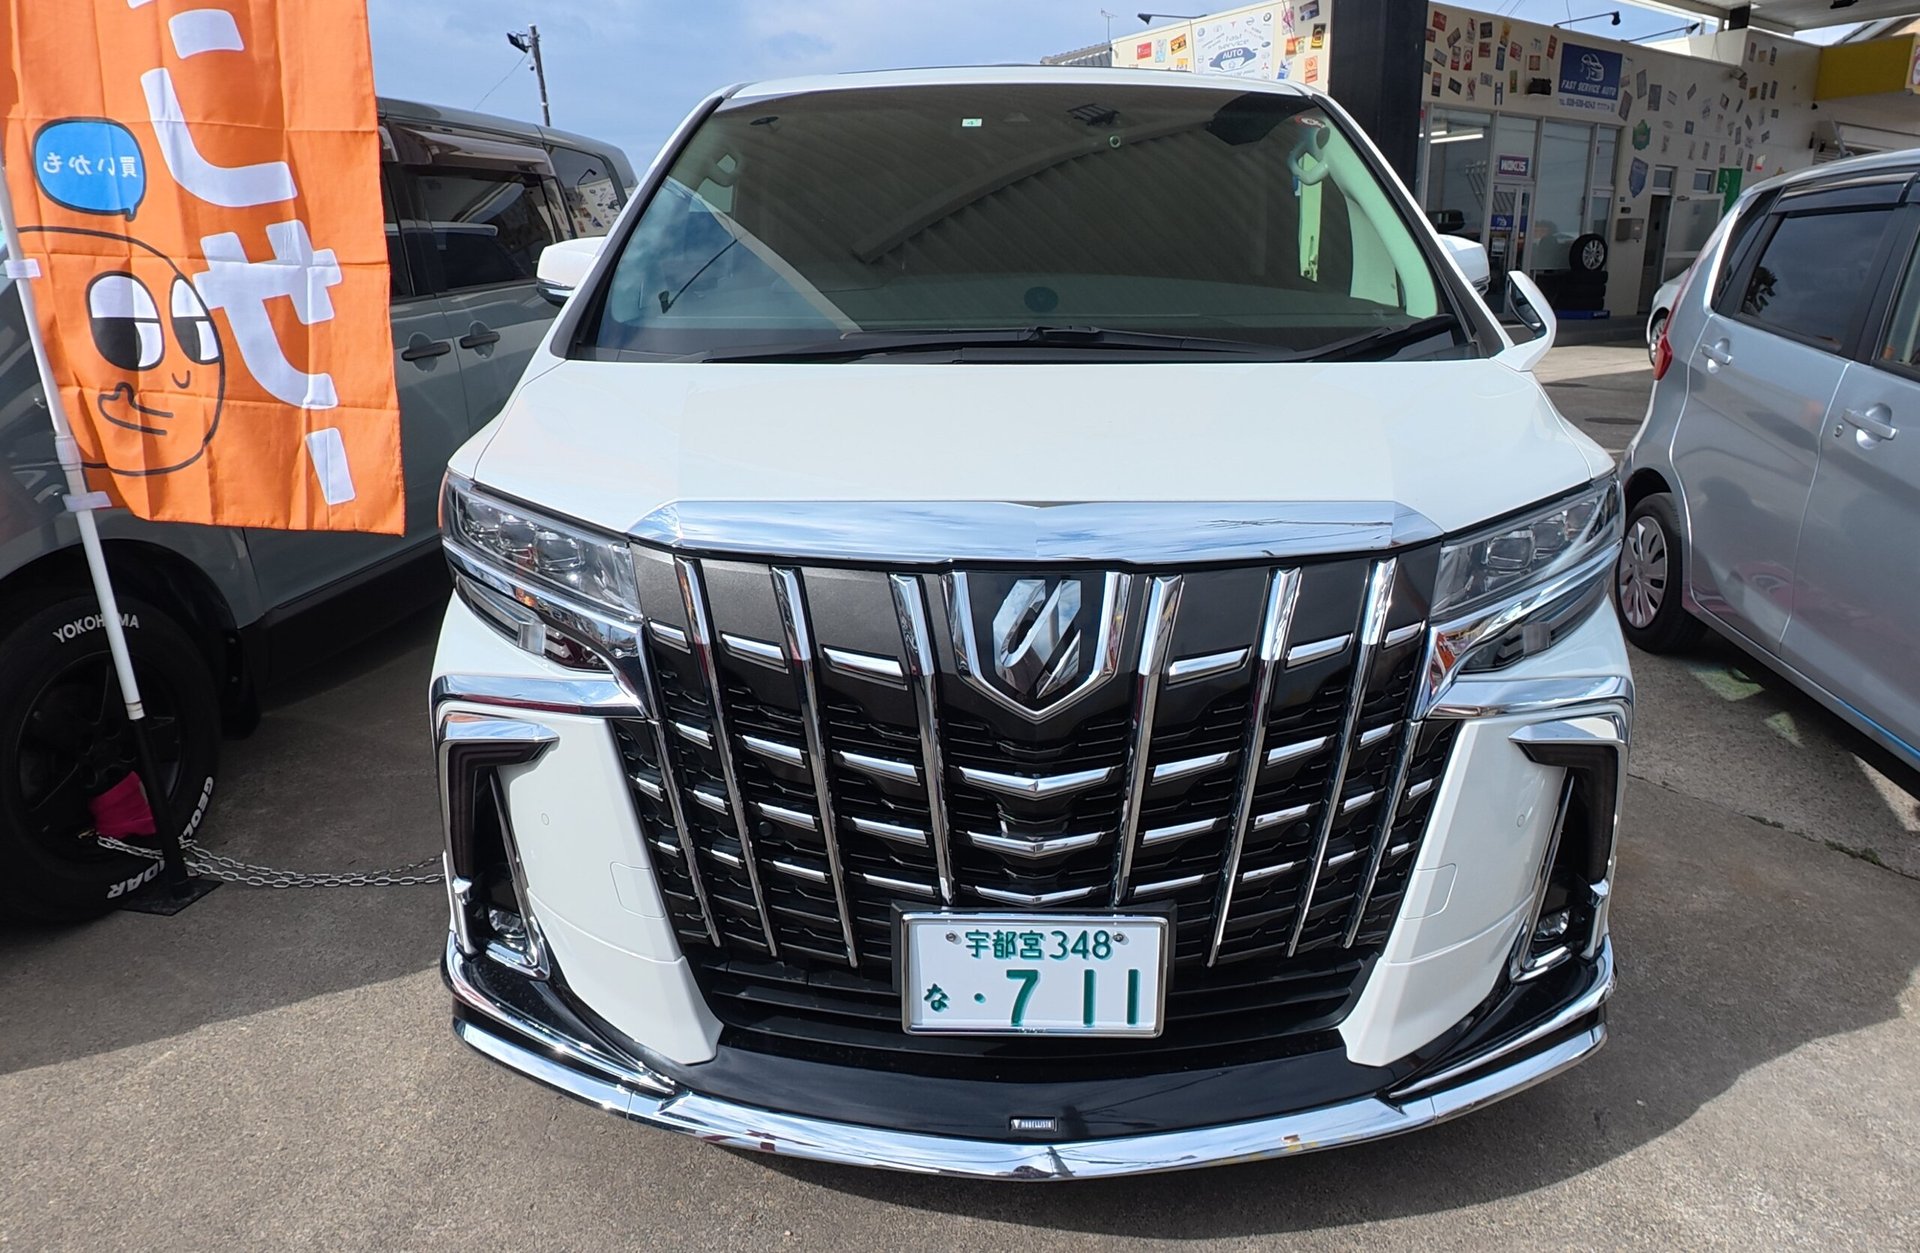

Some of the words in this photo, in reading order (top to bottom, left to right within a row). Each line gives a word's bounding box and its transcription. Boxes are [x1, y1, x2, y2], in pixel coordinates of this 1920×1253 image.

[1222, 49, 1244, 59] AUTO
[52, 613, 140, 643] YOKOHMA
[923, 983, 950, 1013] な
